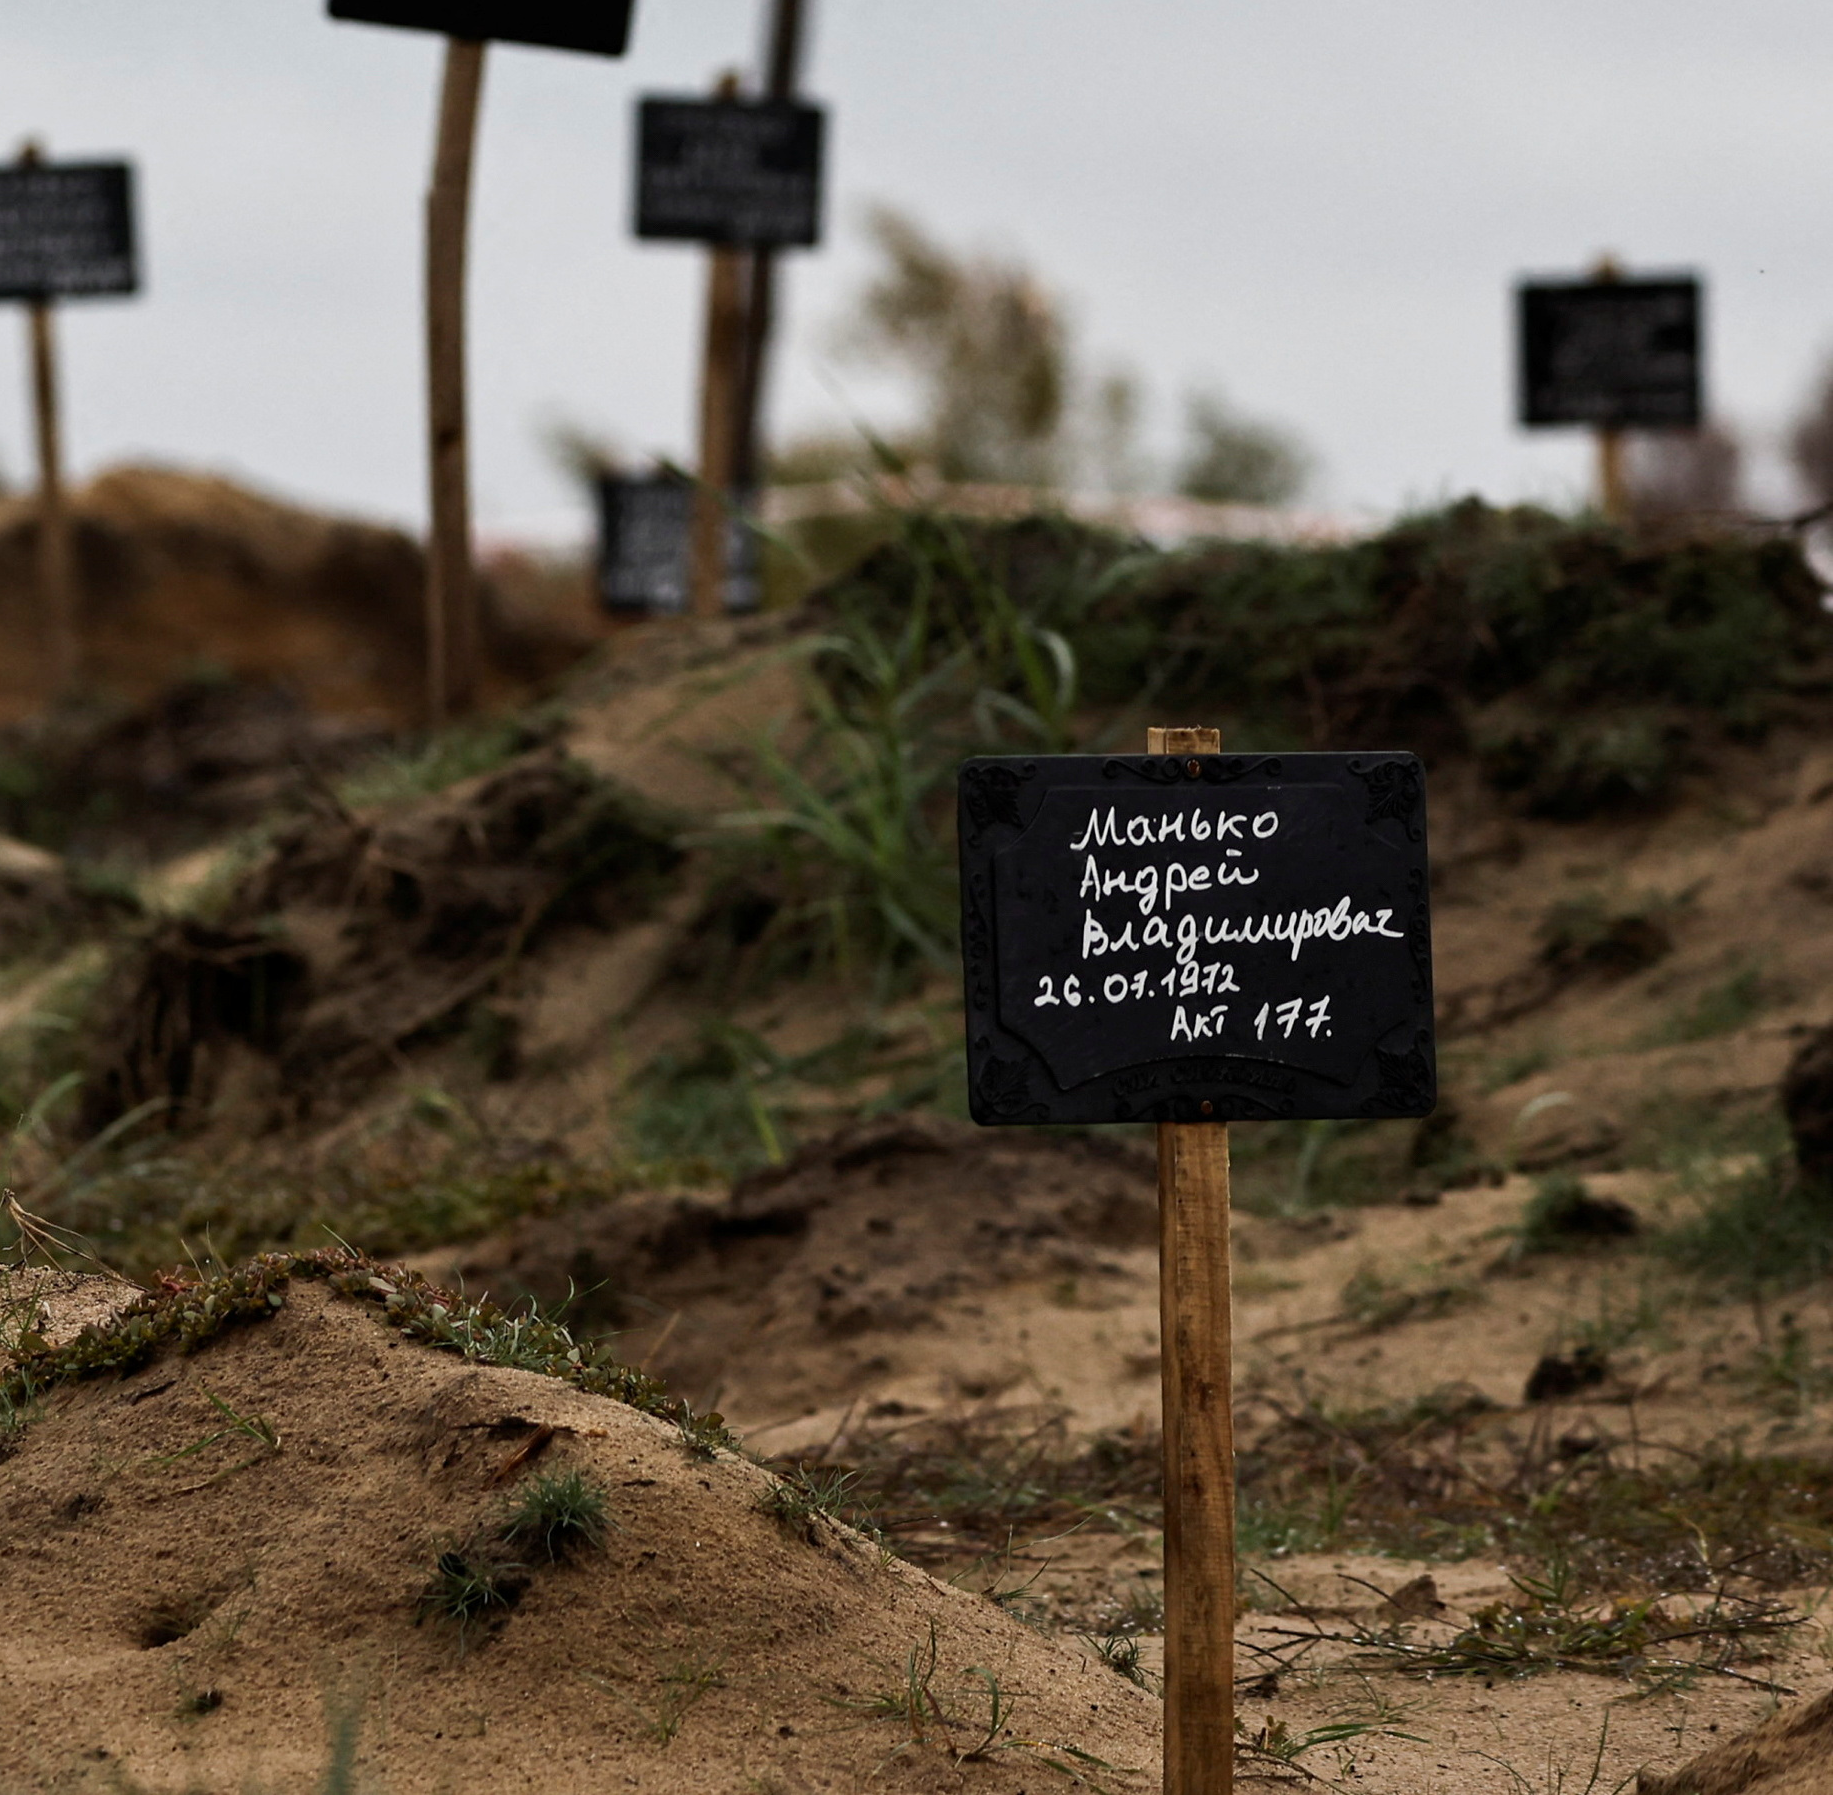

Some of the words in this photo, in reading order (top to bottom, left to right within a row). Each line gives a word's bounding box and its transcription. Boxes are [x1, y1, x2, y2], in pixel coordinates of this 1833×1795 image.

[1069, 805, 1279, 852] Манько
[1079, 848, 1260, 910] Андрей
[1033, 962, 1241, 1009] 26.07.1972
